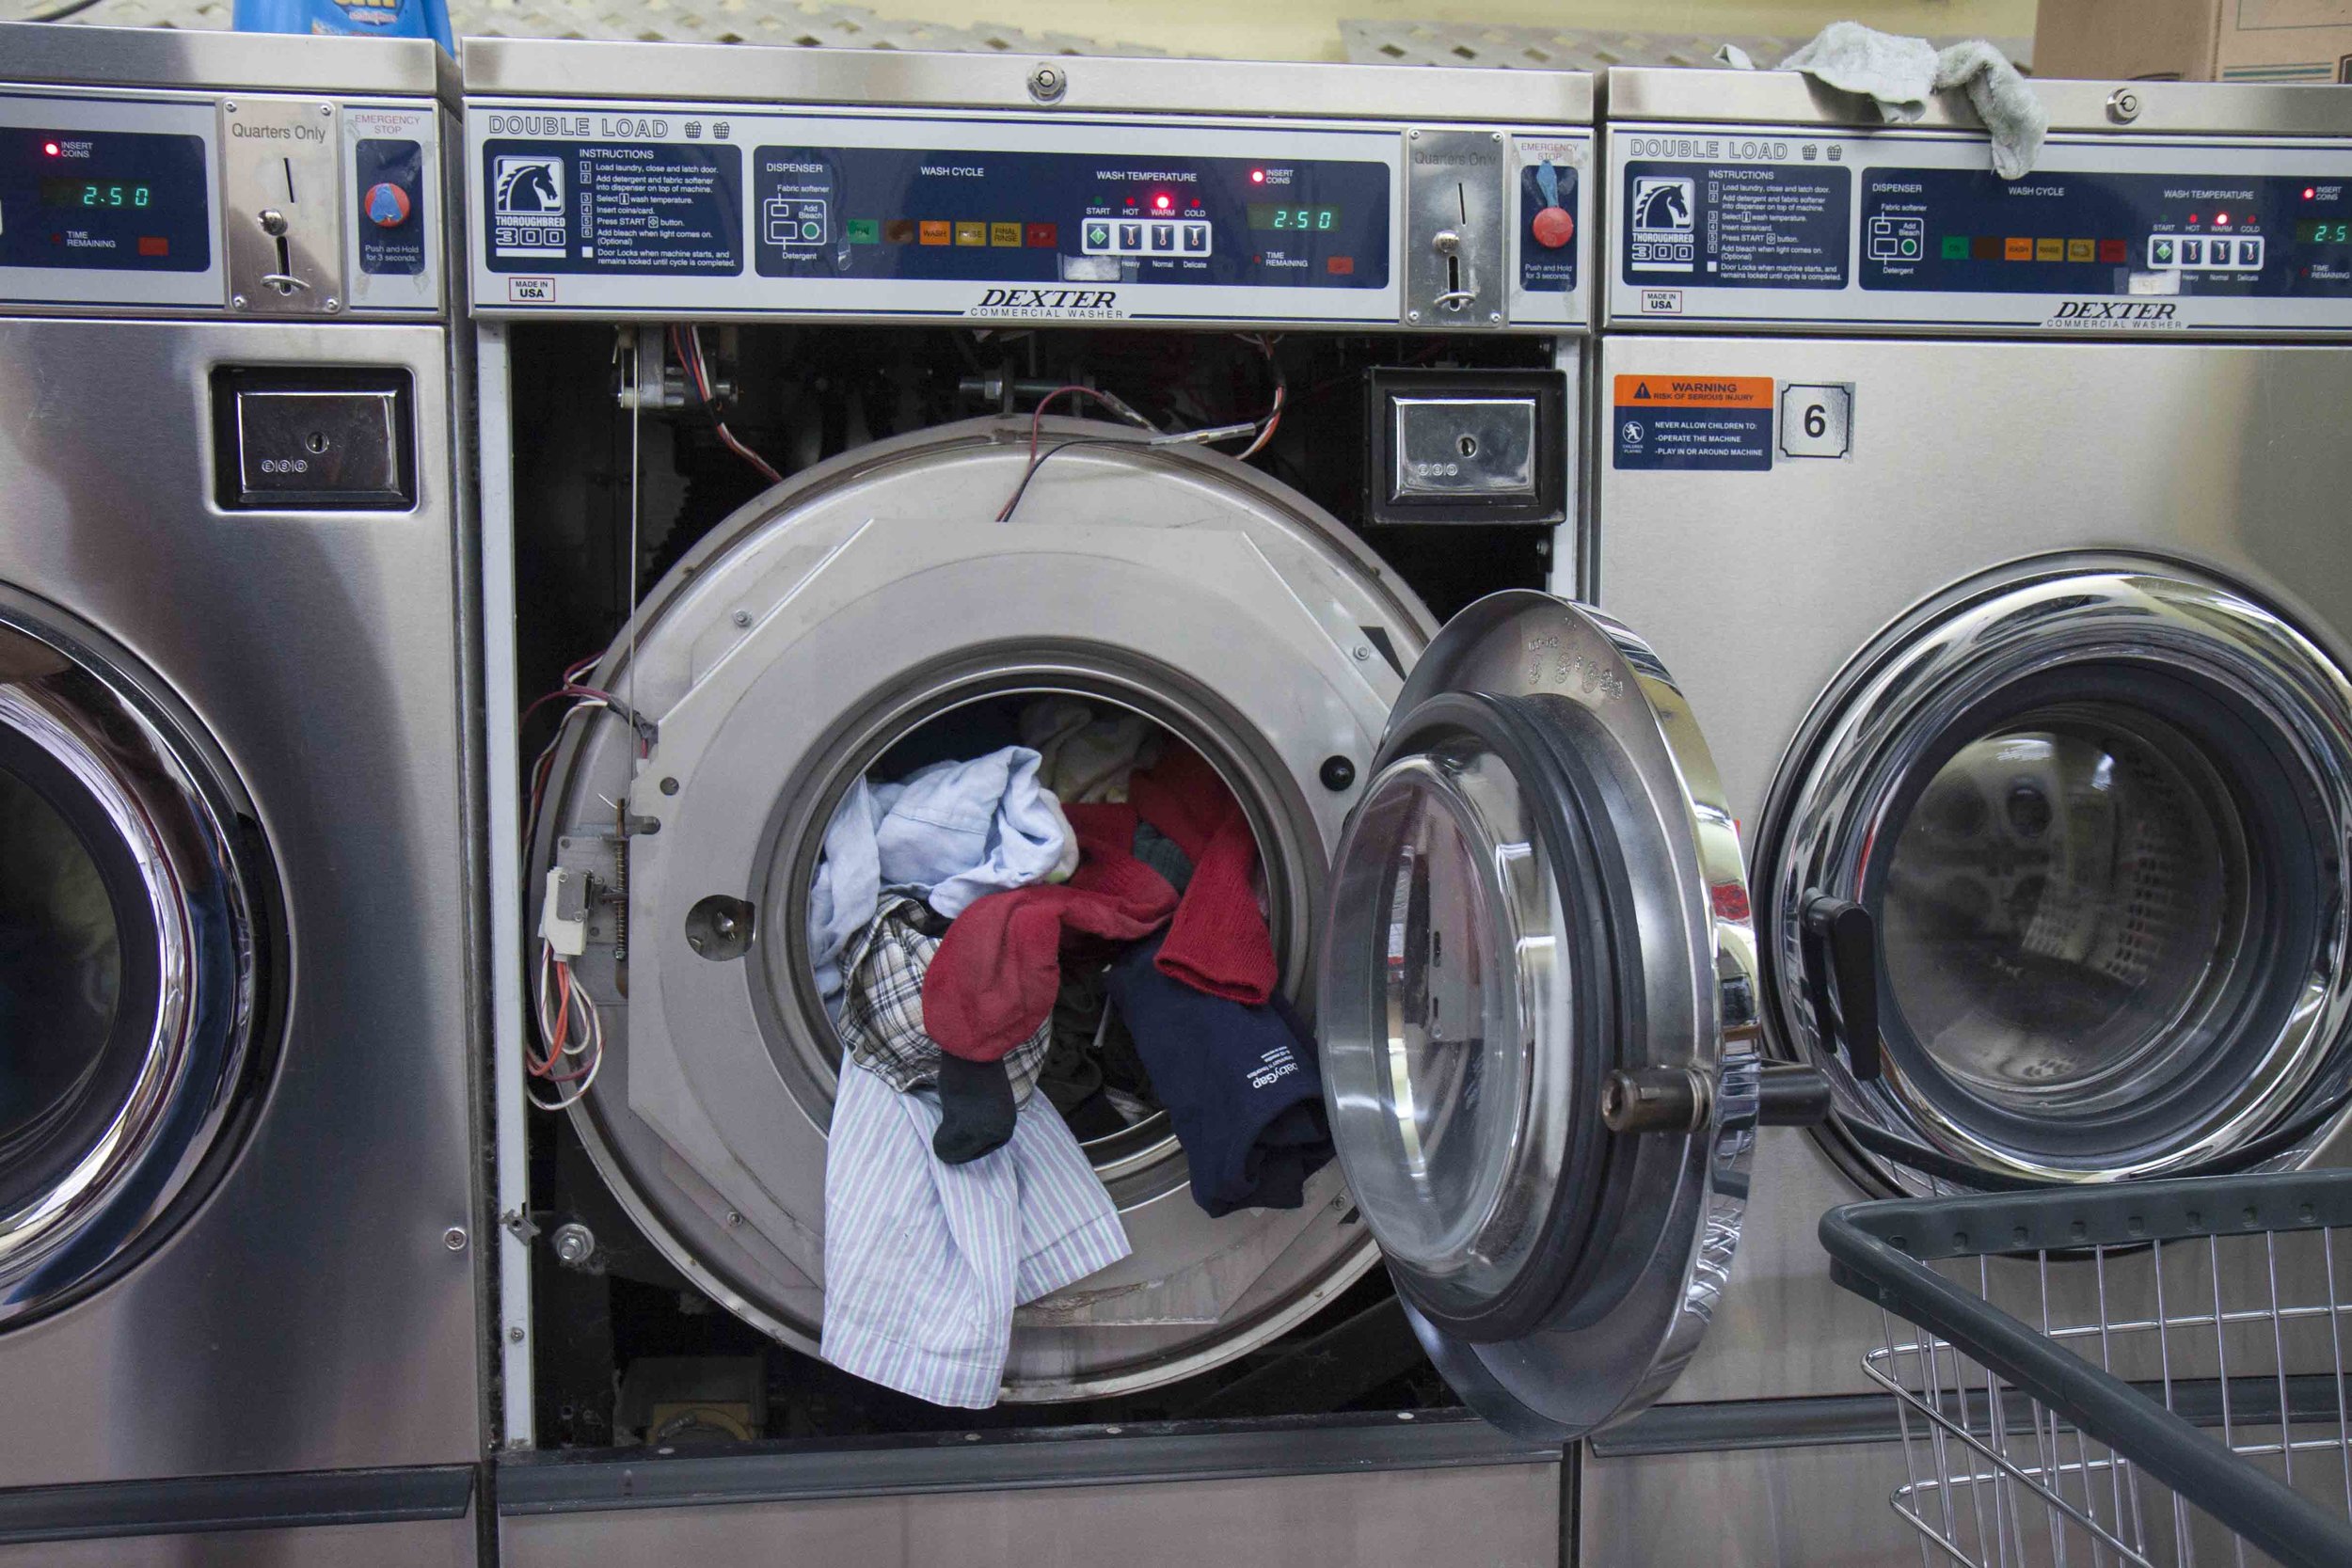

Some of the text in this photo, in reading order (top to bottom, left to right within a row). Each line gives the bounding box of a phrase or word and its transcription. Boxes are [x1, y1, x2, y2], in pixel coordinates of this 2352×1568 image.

[355, 115, 420, 125] EMERGENCY
[374, 125, 402, 135] STOP
[488, 115, 669, 137] DOUBLE LOAD
[232, 123, 326, 143] Quarters Only
[61, 141, 93, 150] INSERT
[1521, 143, 1578, 151] EMERGENCY
[1630, 138, 1788, 160] DOUBLE LOAD
[61, 150, 89, 158] COINS
[580, 149, 654, 159] INSTRUCTIONS
[1538, 152, 1562, 161] STOP
[767, 163, 823, 173] DISPENSER
[921, 166, 984, 177] WASH CYCLE
[1096, 171, 1197, 182] WASH TEMPERATURE
[1708, 170, 1774, 180] INSTRUCTIONS
[1872, 183, 1922, 193] DISPENSER
[2008, 186, 2064, 197] WASH CYCLE
[2164, 190, 2254, 200] WASH TEMPERATURE
[496, 216, 565, 227] THOROUGHBRED
[66, 230, 87, 239] TIME
[496, 228, 565, 245] 300
[660, 230, 675, 239] light
[1632, 232, 1694, 244] THOROUGHBRED
[67, 239, 116, 248] REMAINING
[783, 252, 817, 261] Detergent
[1632, 244, 1693, 261] 300
[519, 289, 544, 297] USA
[977, 289, 1117, 309] DEXTER
[970, 309, 1060, 317] COMMERCIAL
[2054, 301, 2176, 320] DEXTER
[2047, 320, 2125, 328] COMMERCIAL
[1672, 383, 1737, 392] WARNING
[1804, 404, 1826, 438] 6
